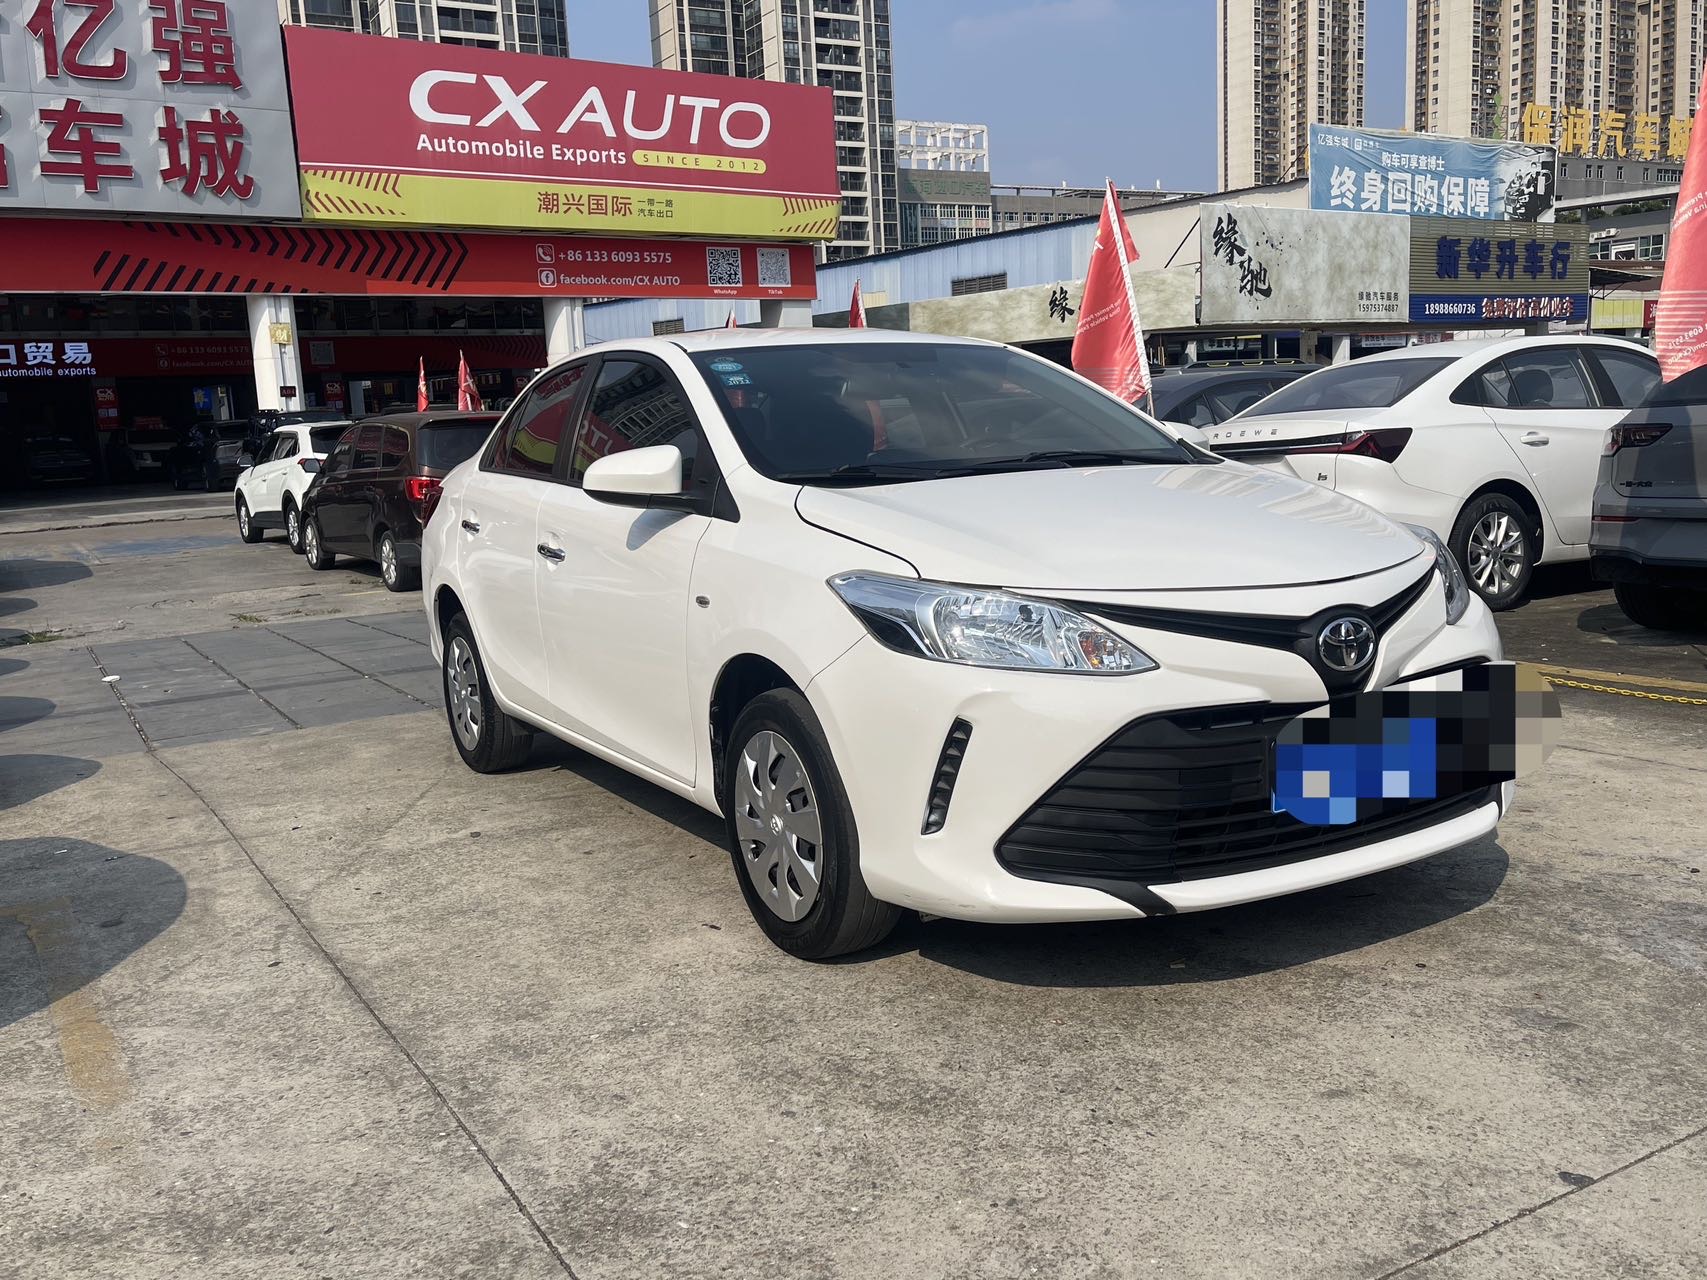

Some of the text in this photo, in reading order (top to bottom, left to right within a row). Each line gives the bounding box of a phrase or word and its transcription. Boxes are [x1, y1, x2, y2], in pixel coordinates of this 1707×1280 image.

[25, 0, 244, 91] 亿强
[409, 69, 771, 149] CX AUTO
[1317, 133, 1349, 148] 亿强车城
[0, 98, 255, 200] 车城
[416, 133, 627, 166] Automobile Exports
[642, 153, 760, 171] SINCE 2012
[1381, 151, 1445, 171] 购车可享查博士
[1329, 164, 1491, 218] 终身回购保障
[537, 191, 633, 217] 潮兴国际
[637, 198, 674, 208] 一带一路
[637, 208, 674, 218] 汽车出口
[558, 250, 672, 264] +86 133 6093 5575
[560, 273, 681, 287] facebook.com/CX AUTO
[1425, 303, 1476, 315] 18988660736
[58, 367, 96, 377] exports
[1213, 428, 1278, 439] ROEWE
